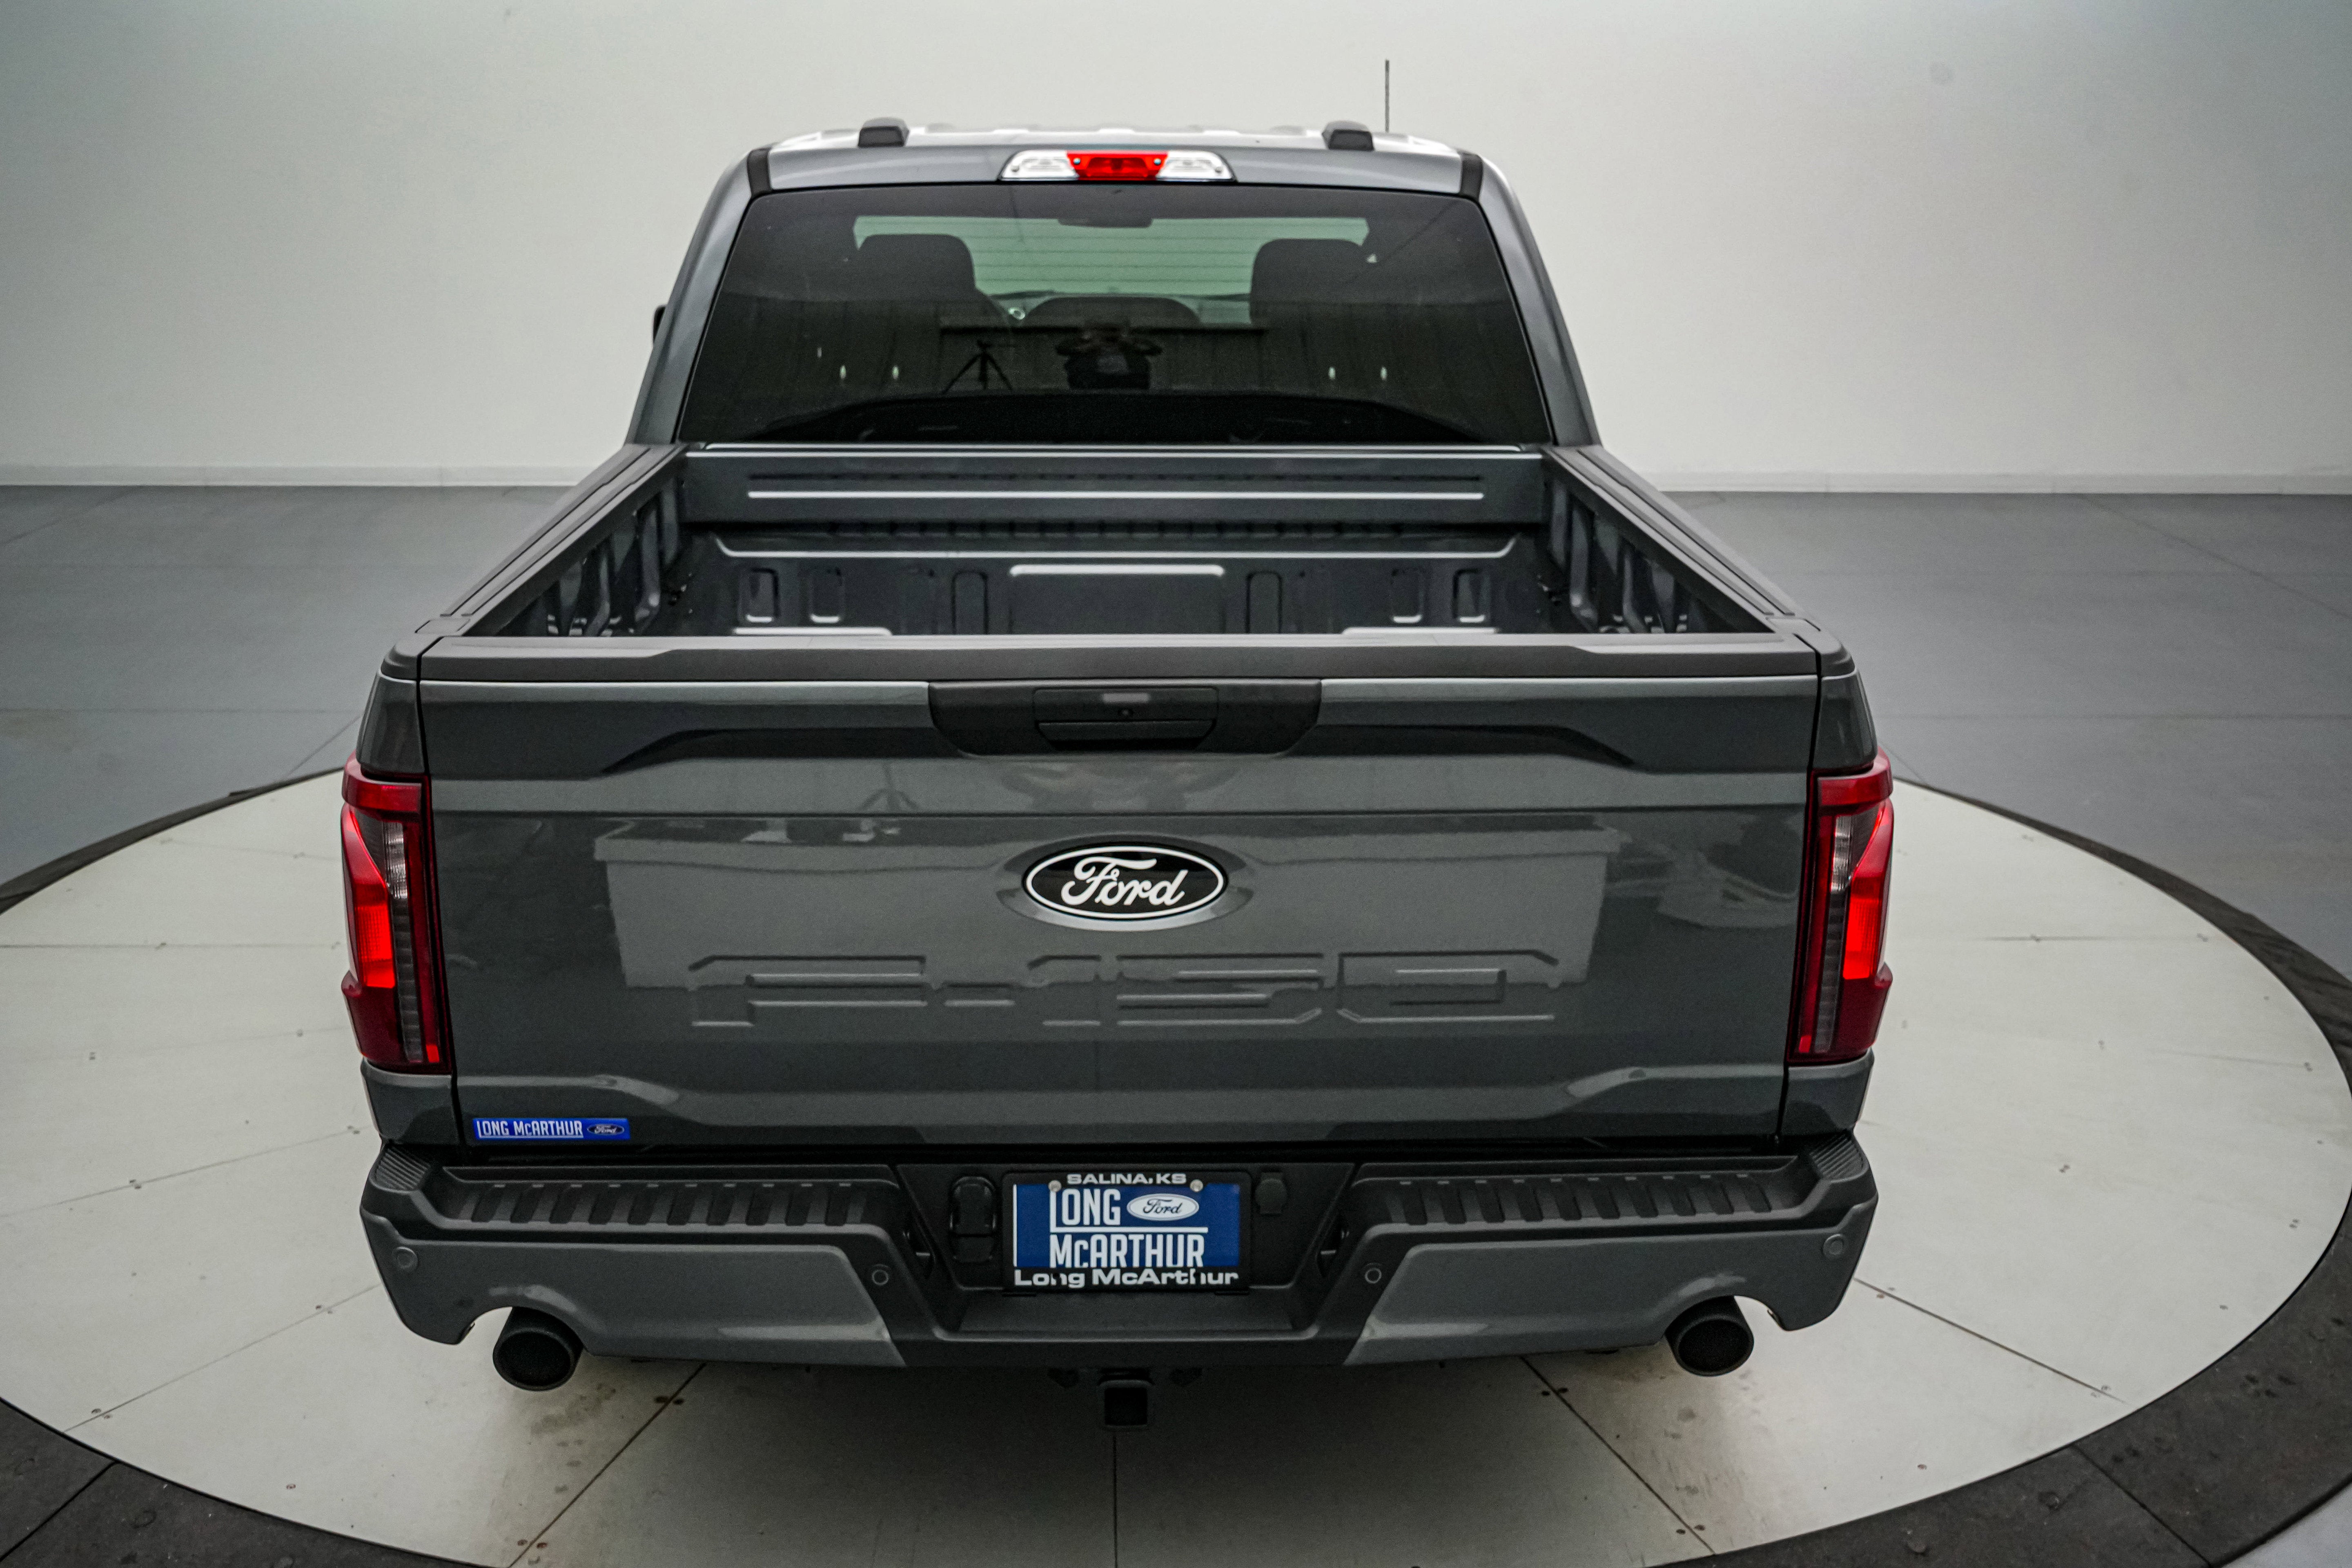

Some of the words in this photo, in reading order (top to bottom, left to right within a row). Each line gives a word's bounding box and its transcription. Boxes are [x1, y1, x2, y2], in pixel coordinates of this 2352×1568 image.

[1062, 857, 1188, 906] Ford
[688, 951, 1561, 1028] F-150
[477, 1120, 509, 1138] LONG
[514, 1120, 583, 1136] McARTHUR
[594, 1125, 617, 1134] Ford
[1067, 1173, 1152, 1185] SALINA,
[1156, 1173, 1187, 1184] KS
[1050, 1189, 1121, 1233] LONG
[1143, 1198, 1183, 1215] Ford
[1050, 1234, 1205, 1267] McARTHUR
[1015, 1269, 1085, 1289] Long
[1092, 1268, 1238, 1285] McArthur
